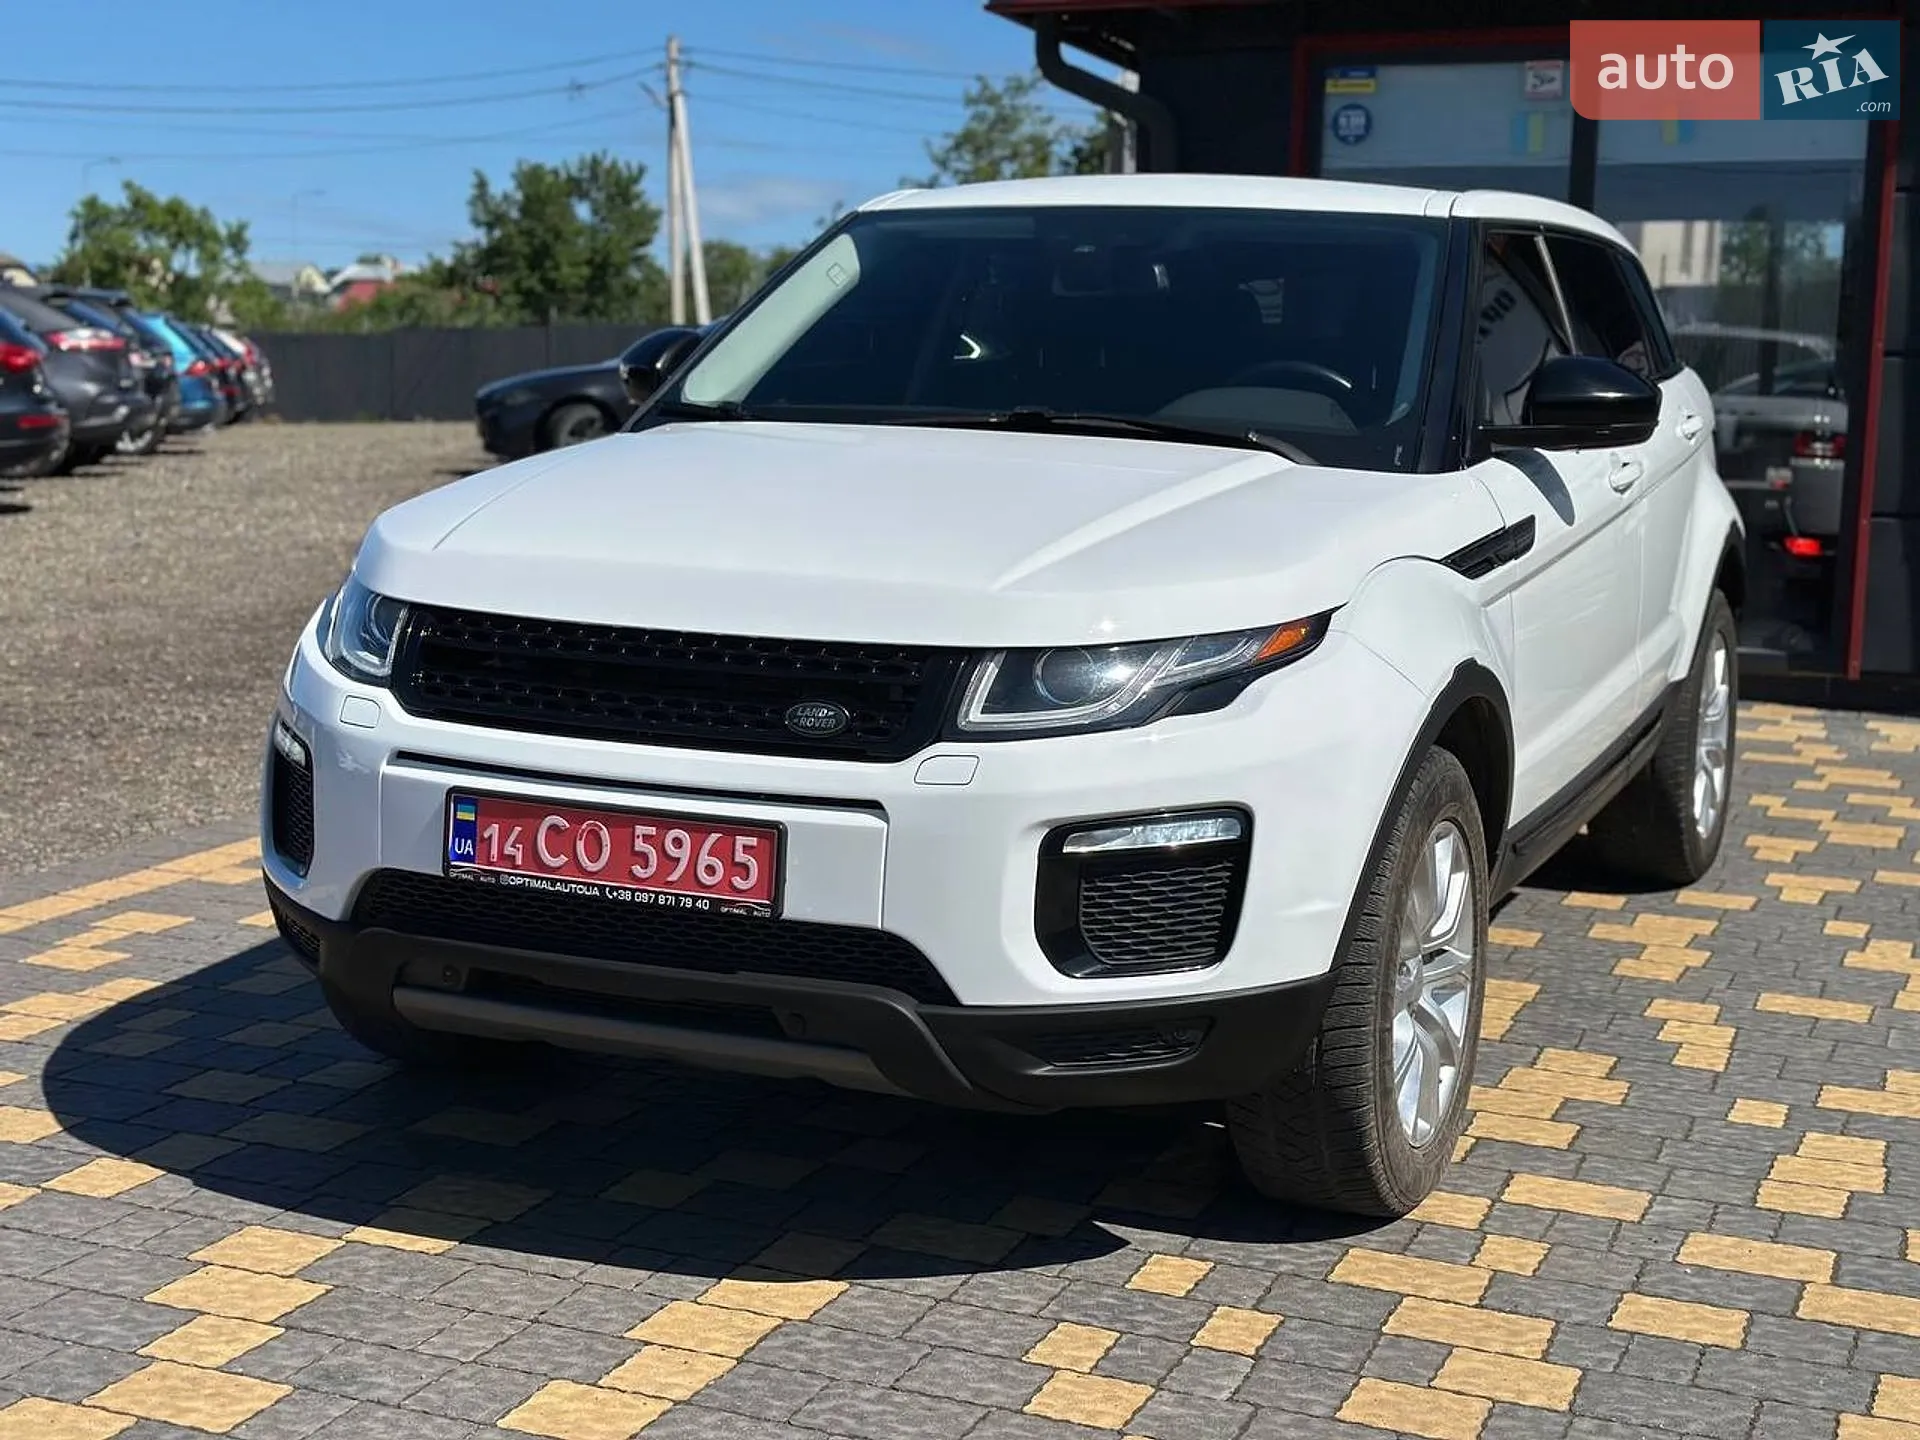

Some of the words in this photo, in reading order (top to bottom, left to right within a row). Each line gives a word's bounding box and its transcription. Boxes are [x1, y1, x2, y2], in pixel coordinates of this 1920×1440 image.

[797, 708, 828, 717] LAND
[799, 717, 836, 729] ROVER
[455, 838, 474, 855] UA
[483, 823, 523, 865] 14
[536, 815, 611, 873] CO
[631, 825, 759, 891] 5965
[612, 889, 631, 902] +38
[634, 892, 655, 904] 097
[658, 894, 676, 907] 871
[679, 896, 693, 908] 79
[695, 898, 710, 910] 40
